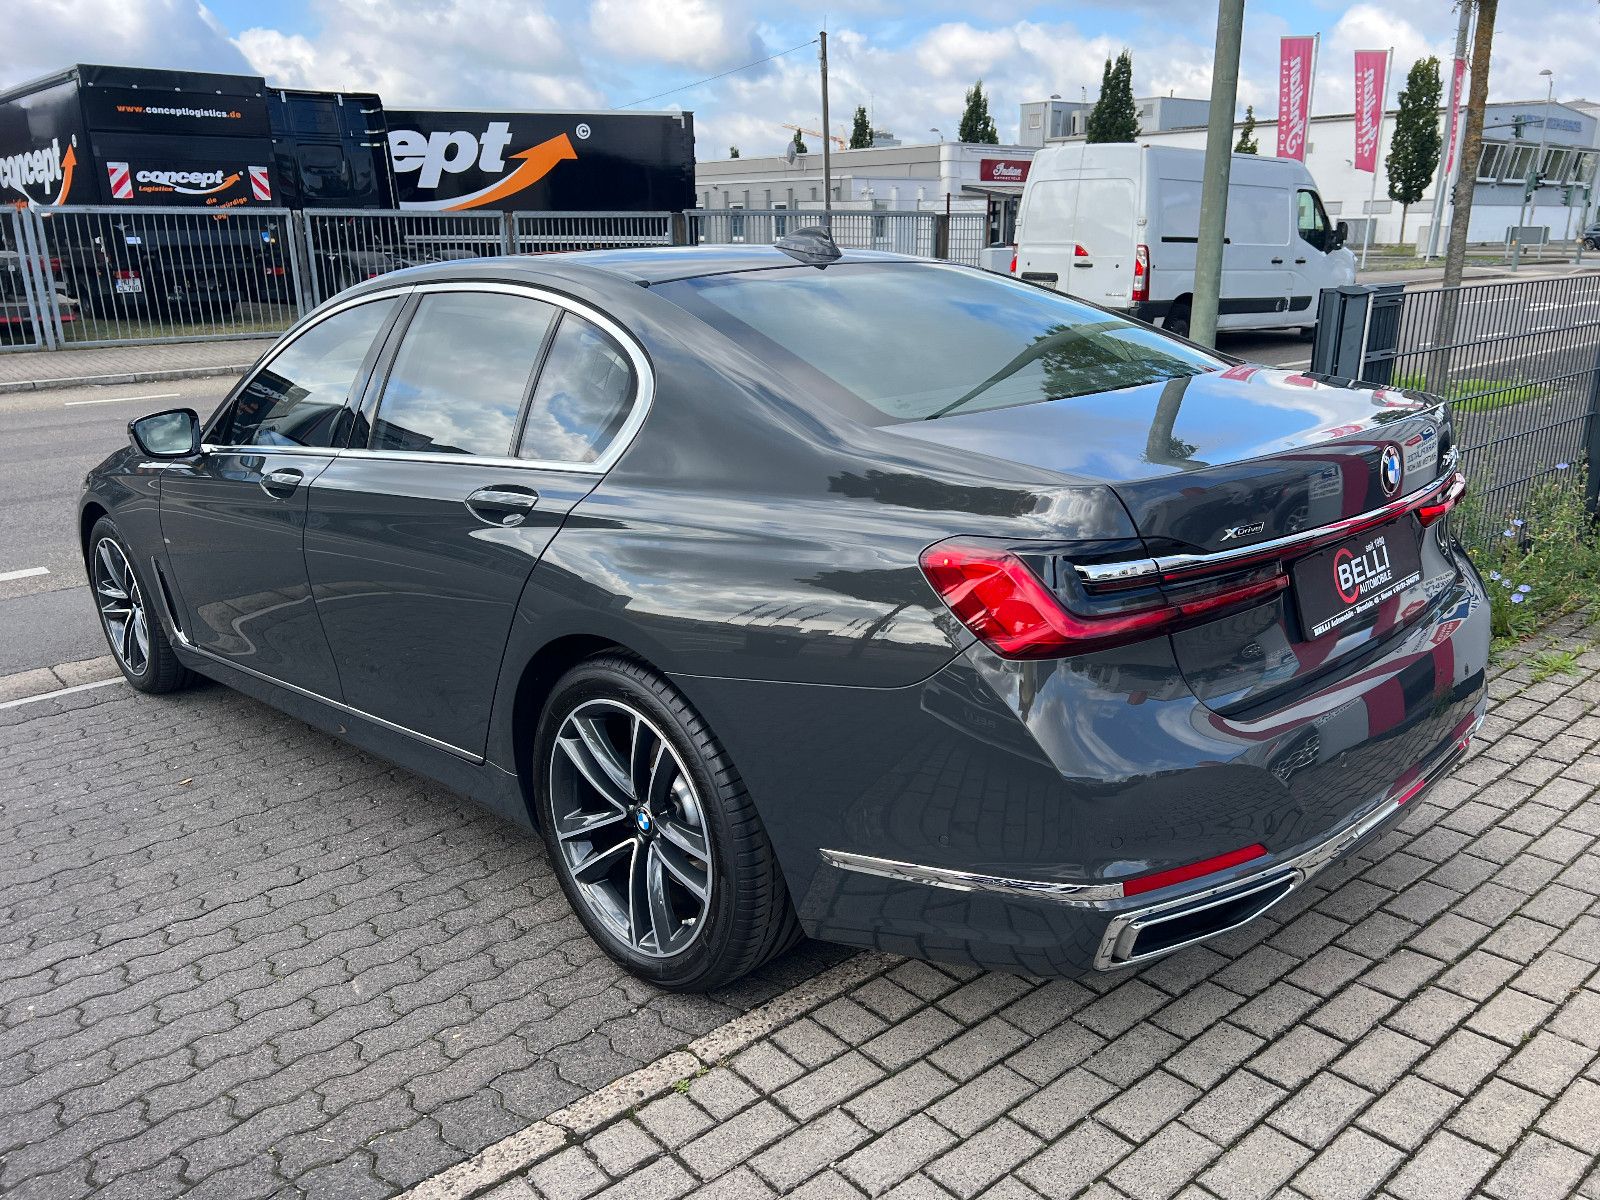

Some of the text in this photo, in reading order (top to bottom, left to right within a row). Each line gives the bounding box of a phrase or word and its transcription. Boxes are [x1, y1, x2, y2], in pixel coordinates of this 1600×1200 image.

[116, 105, 242, 119] www.conceptlogistics.de
[136, 170, 224, 187] concept
[1338, 545, 1390, 591] BELLI
[1360, 569, 1393, 595] AUTOMOBILE
